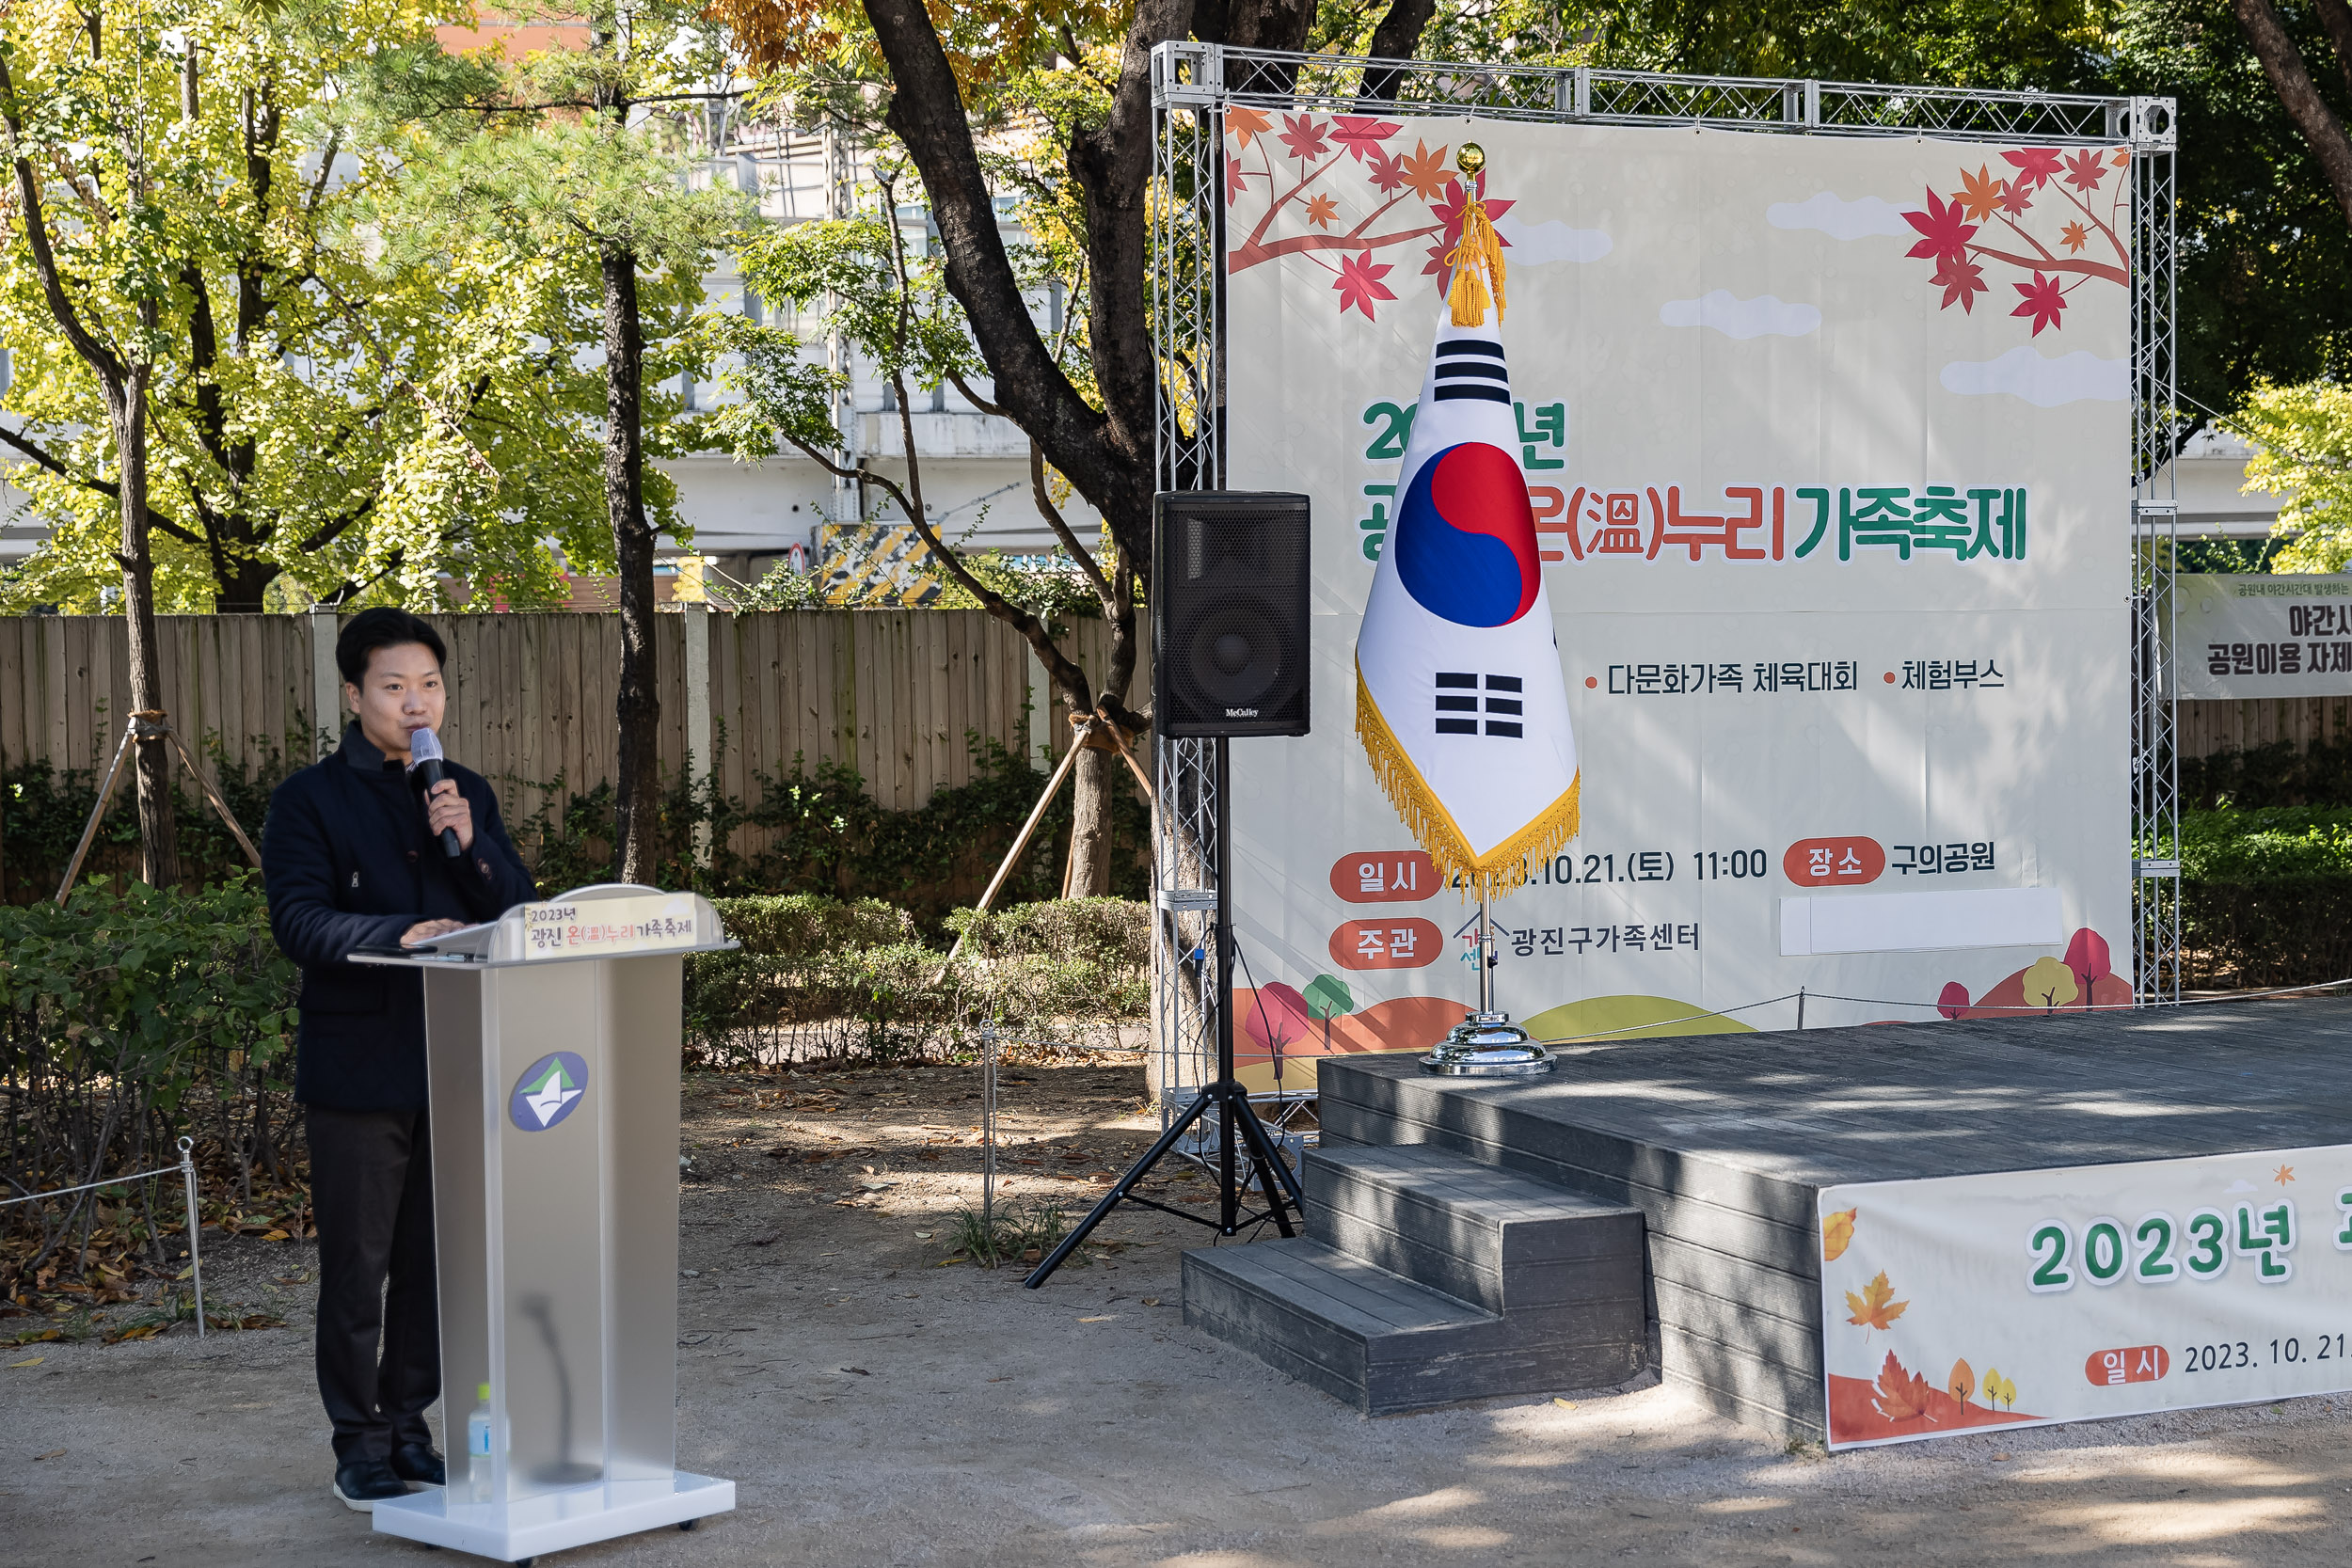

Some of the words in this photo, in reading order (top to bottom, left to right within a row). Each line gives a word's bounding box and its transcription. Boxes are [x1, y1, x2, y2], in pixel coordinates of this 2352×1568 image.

[2238, 583, 2265, 597] 공원내
[2268, 583, 2312, 596] 야간시간대
[2314, 582, 2349, 596] 발생하는
[2207, 642, 2301, 675] 공원이용
[1608, 663, 1743, 694] 다문화가족
[1752, 660, 1858, 692] 체육대회
[1901, 658, 2005, 690] 체험부스
[1692, 848, 1767, 881] 11:00
[1891, 841, 1995, 876] 구의공원
[531, 907, 576, 923] 2023년
[531, 927, 563, 949] 광진
[1510, 922, 1700, 958] 광진구가족센터
[2030, 1203, 2292, 1288] 2023년
